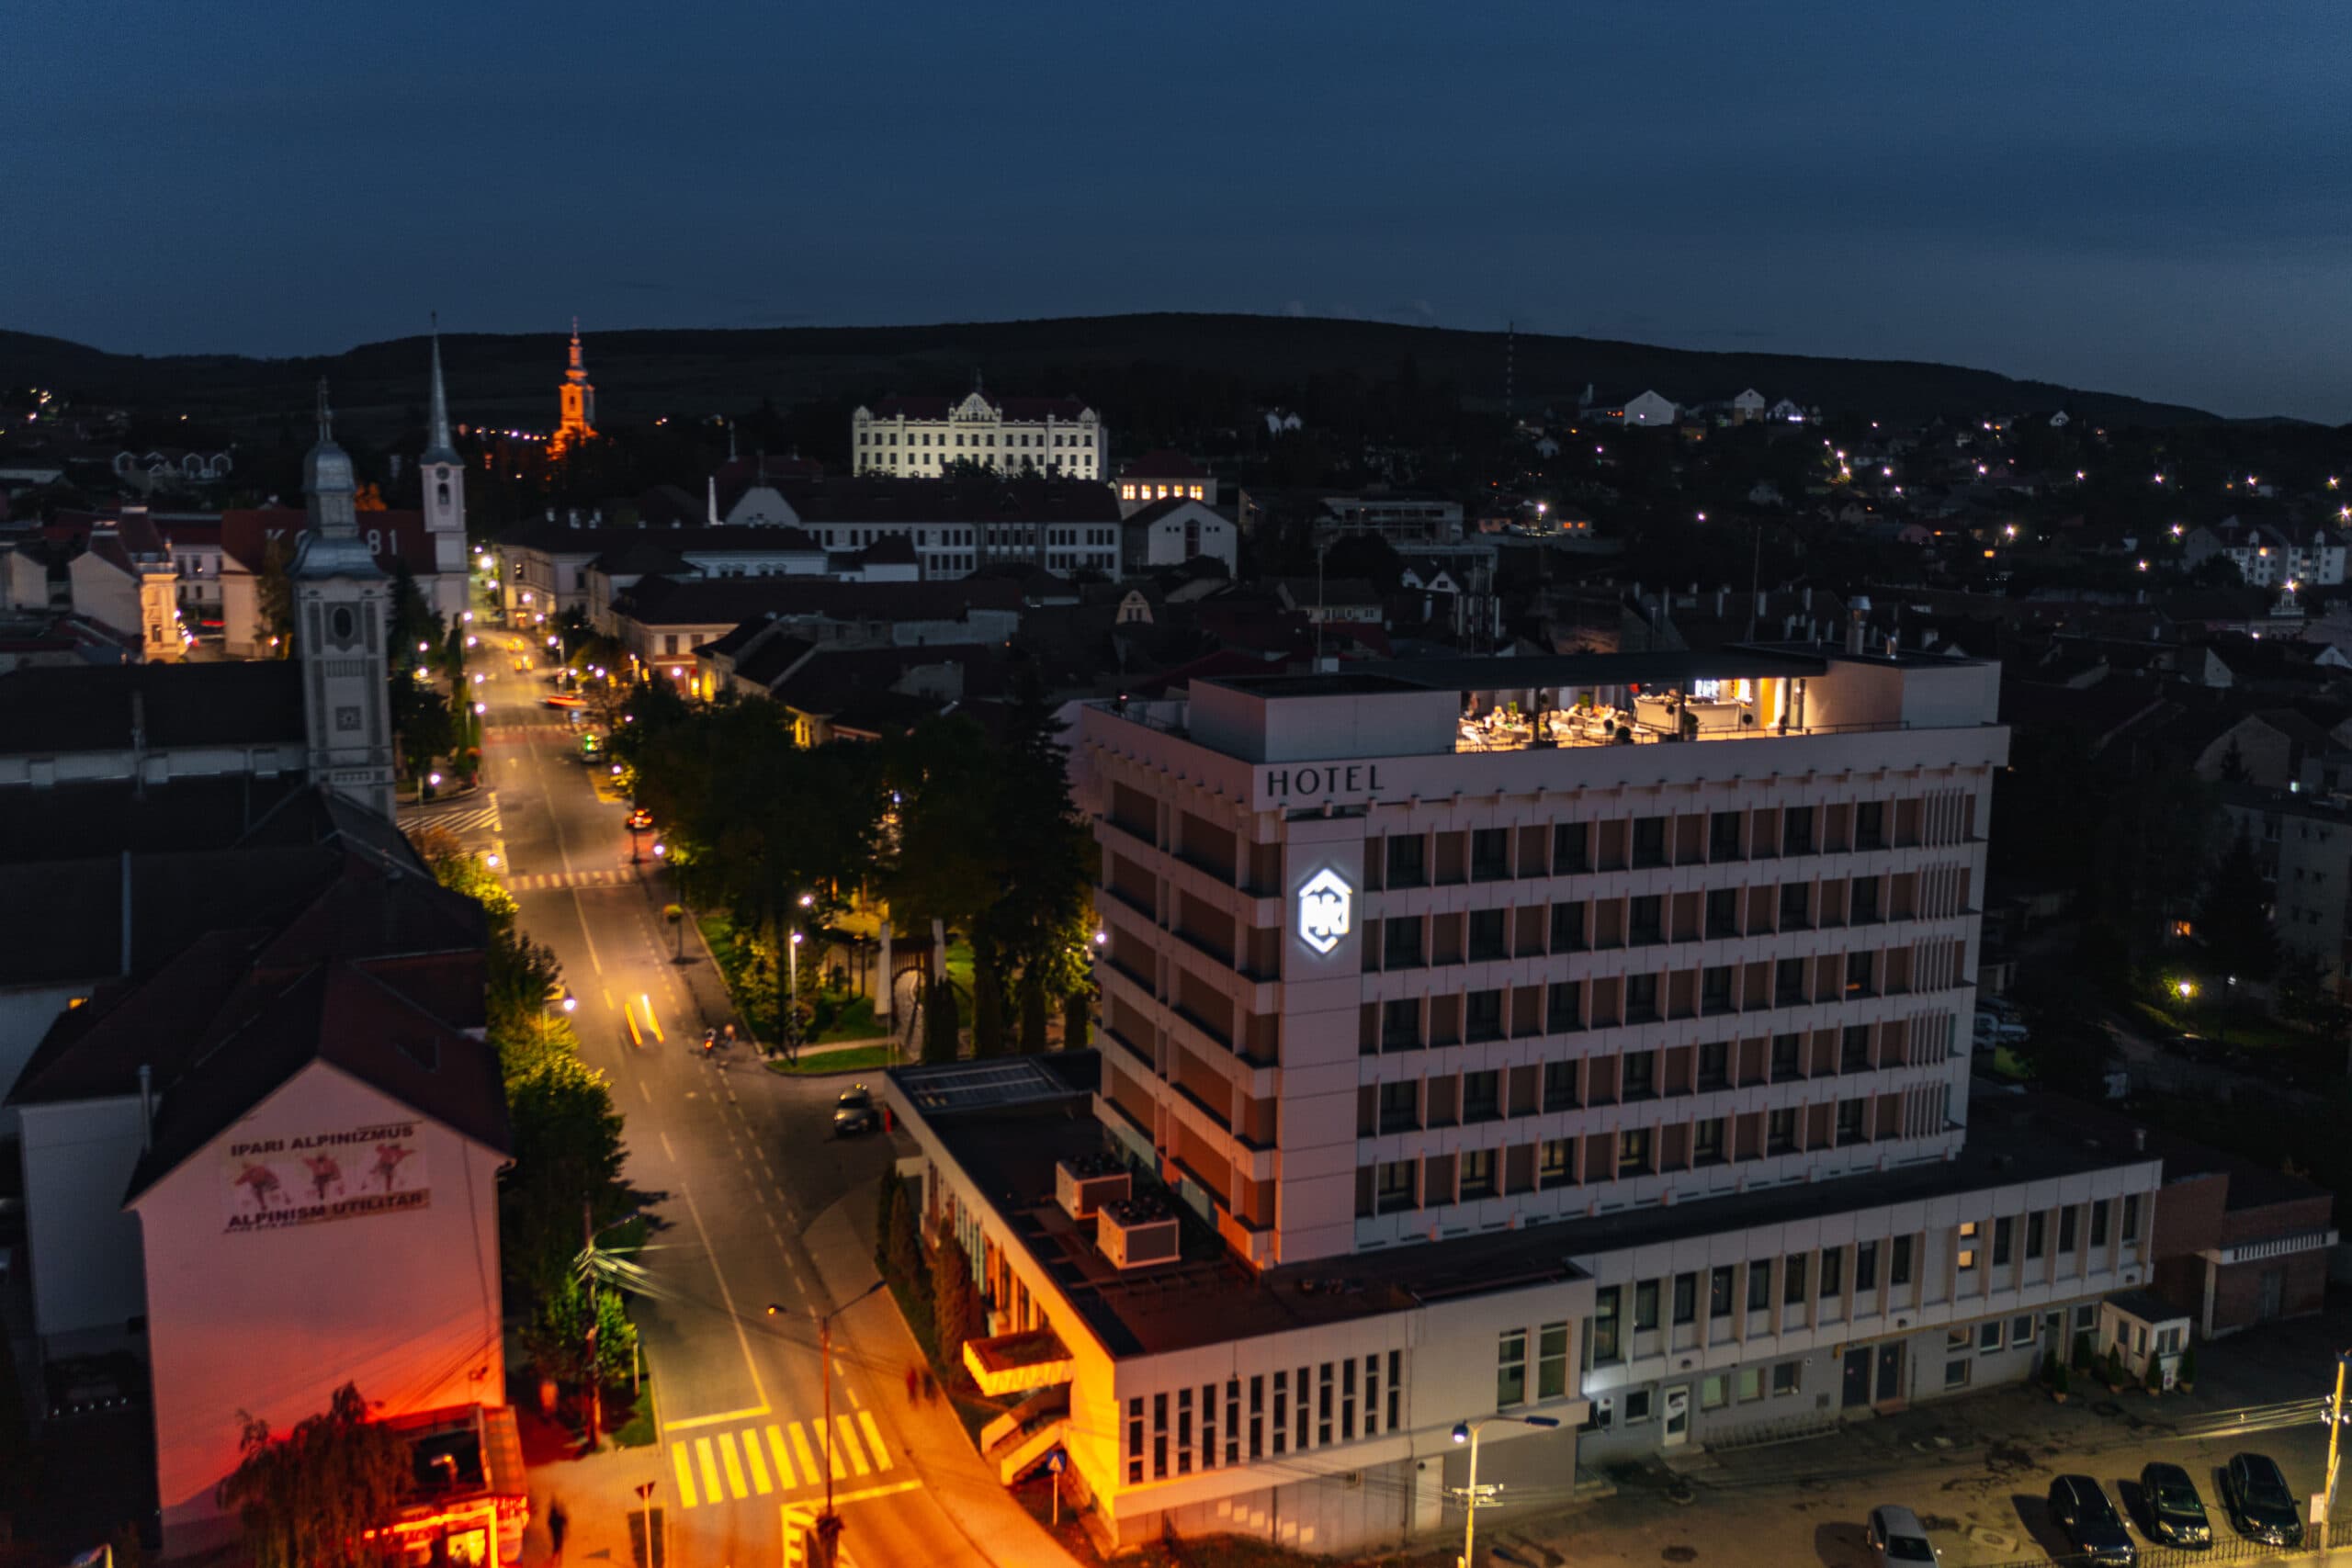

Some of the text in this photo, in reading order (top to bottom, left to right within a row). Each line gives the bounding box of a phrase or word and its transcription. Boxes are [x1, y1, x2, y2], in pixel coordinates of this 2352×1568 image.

[1268, 764, 1385, 796] HOTEL
[231, 1125, 413, 1157] IPARI ALPINIZMUS
[228, 1205, 326, 1228] ALPINISM
[333, 1193, 423, 1216] UTILITAR
